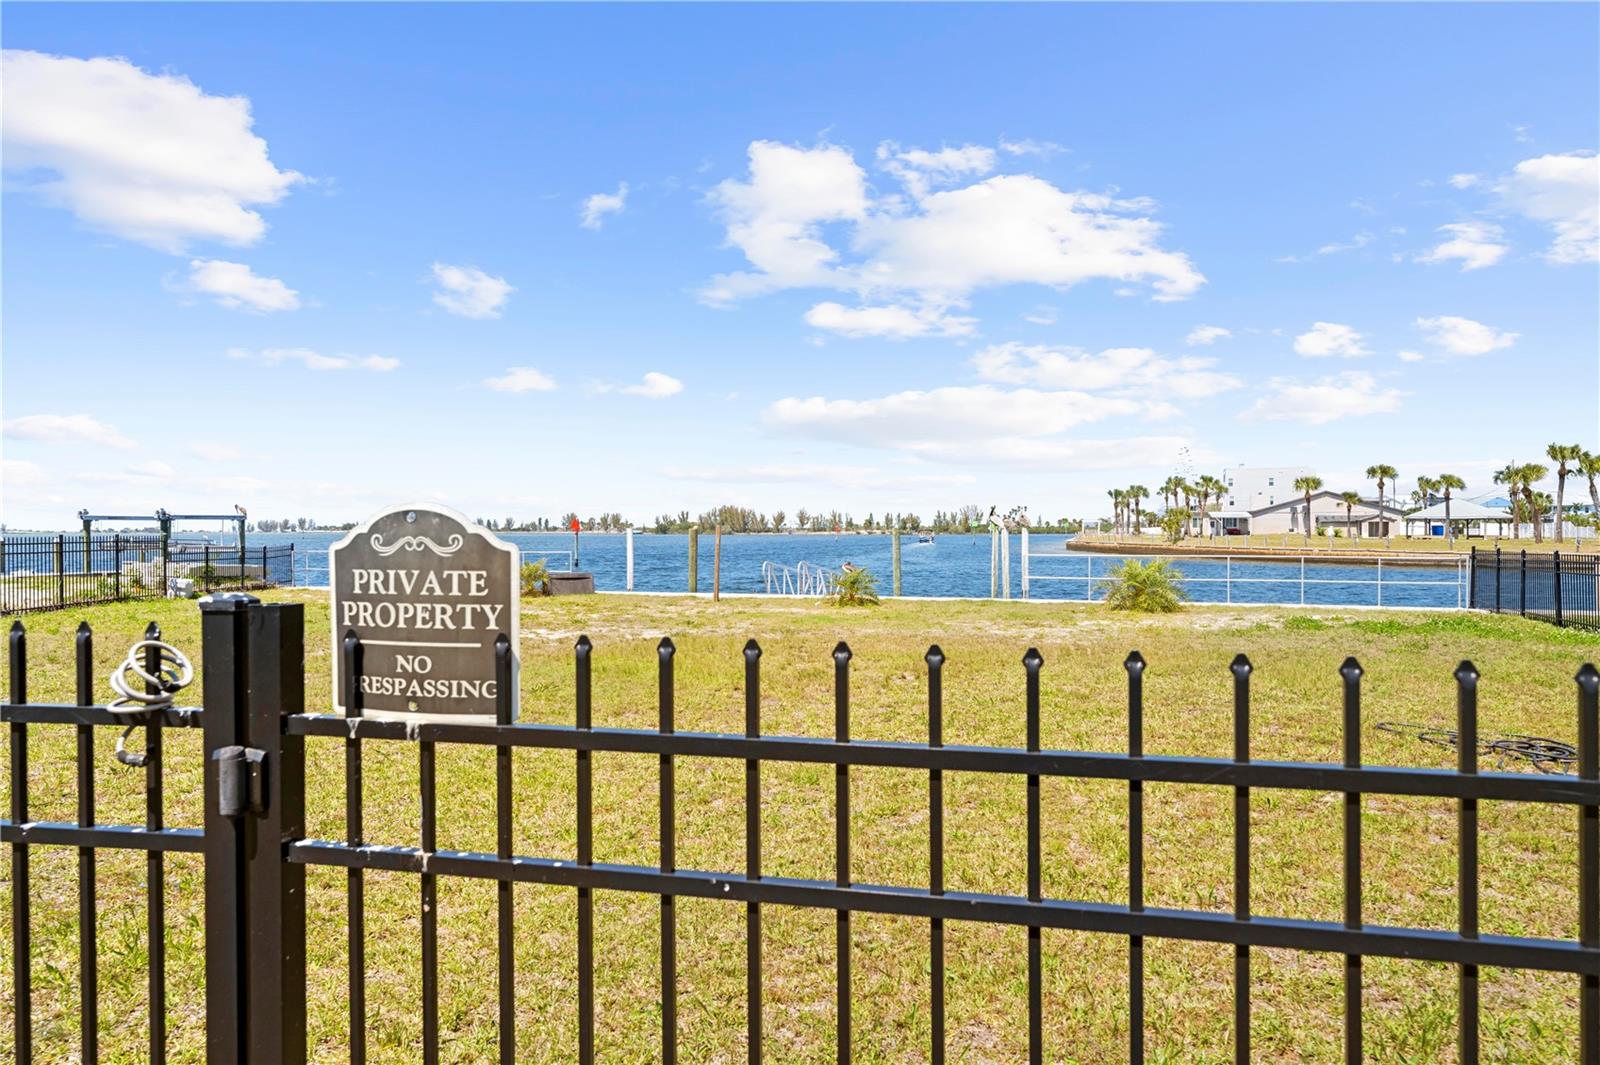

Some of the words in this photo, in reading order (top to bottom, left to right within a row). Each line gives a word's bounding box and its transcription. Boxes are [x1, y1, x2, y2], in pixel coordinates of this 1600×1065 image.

[352, 568, 489, 597] PRIVATE
[342, 601, 504, 630] PROPERTY
[395, 654, 433, 674] NO
[357, 675, 498, 699] RESPASSING
